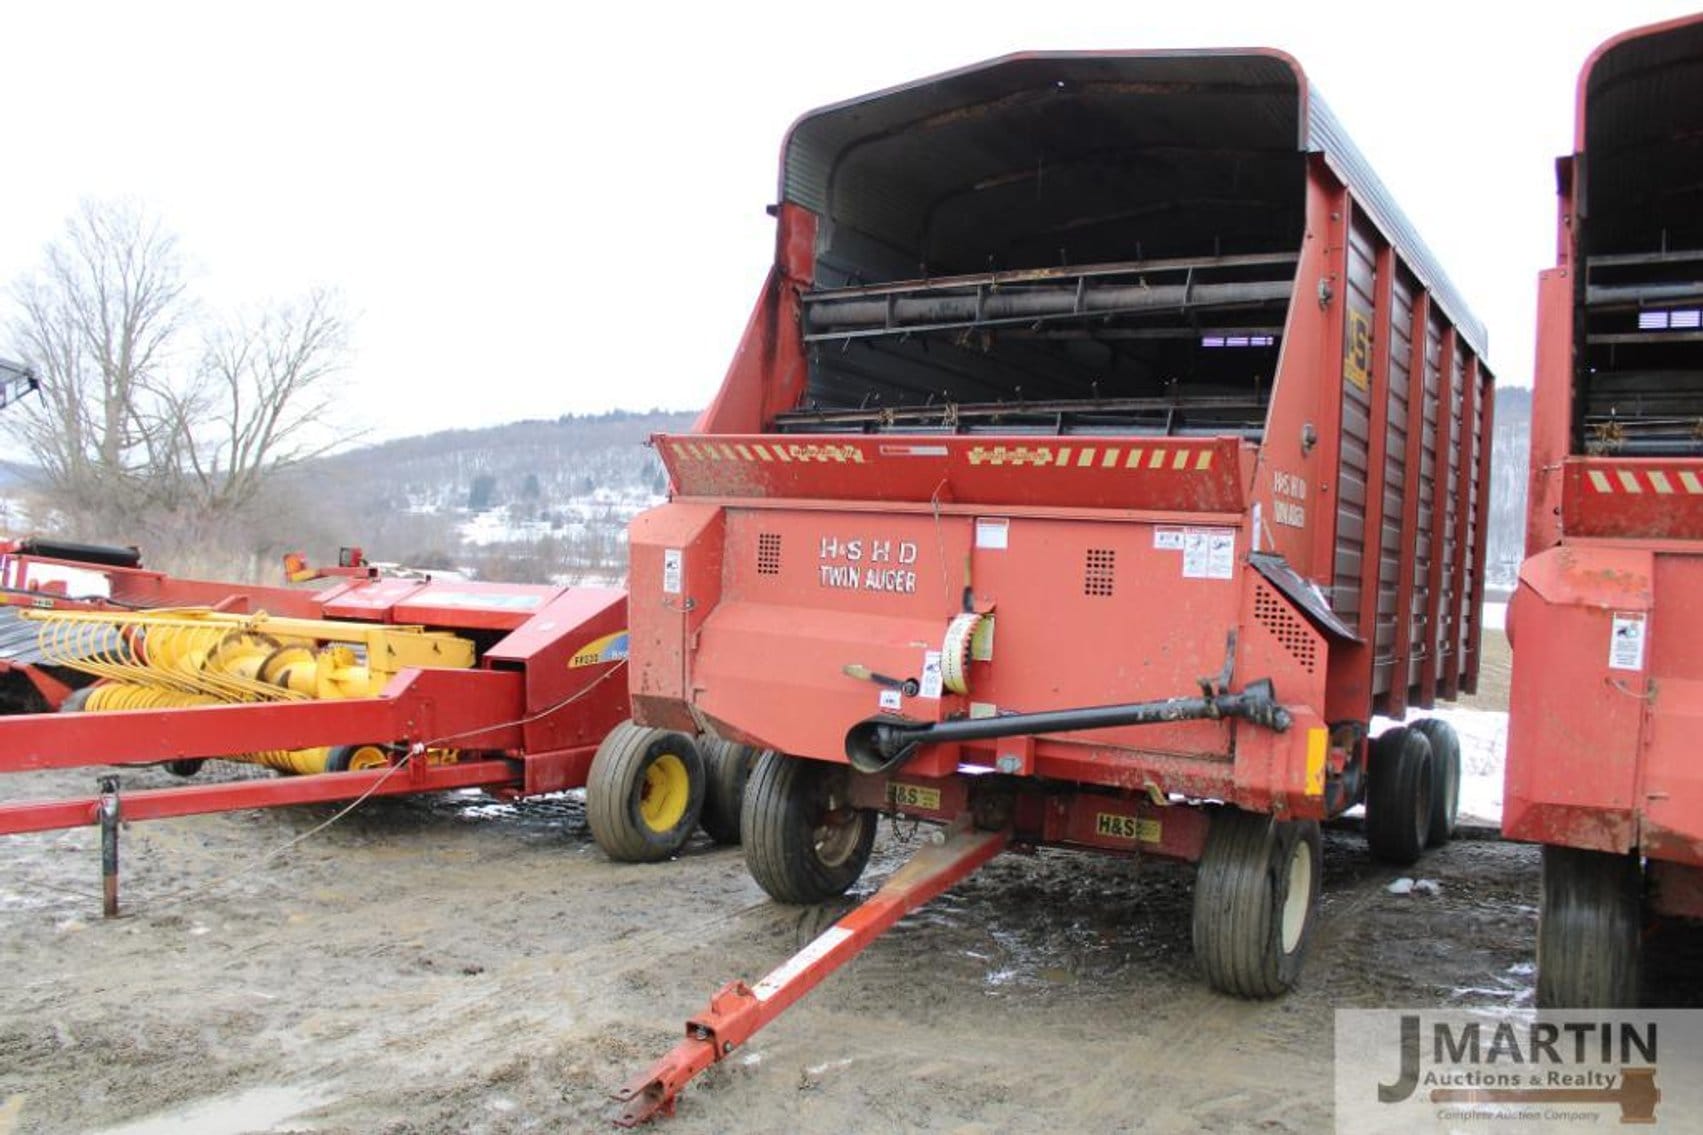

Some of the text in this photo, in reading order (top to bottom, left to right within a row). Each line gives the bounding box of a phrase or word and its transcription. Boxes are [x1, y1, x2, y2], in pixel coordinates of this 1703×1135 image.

[820, 565, 916, 592] TWIN AUGER
[1099, 815, 1134, 837] H&S
